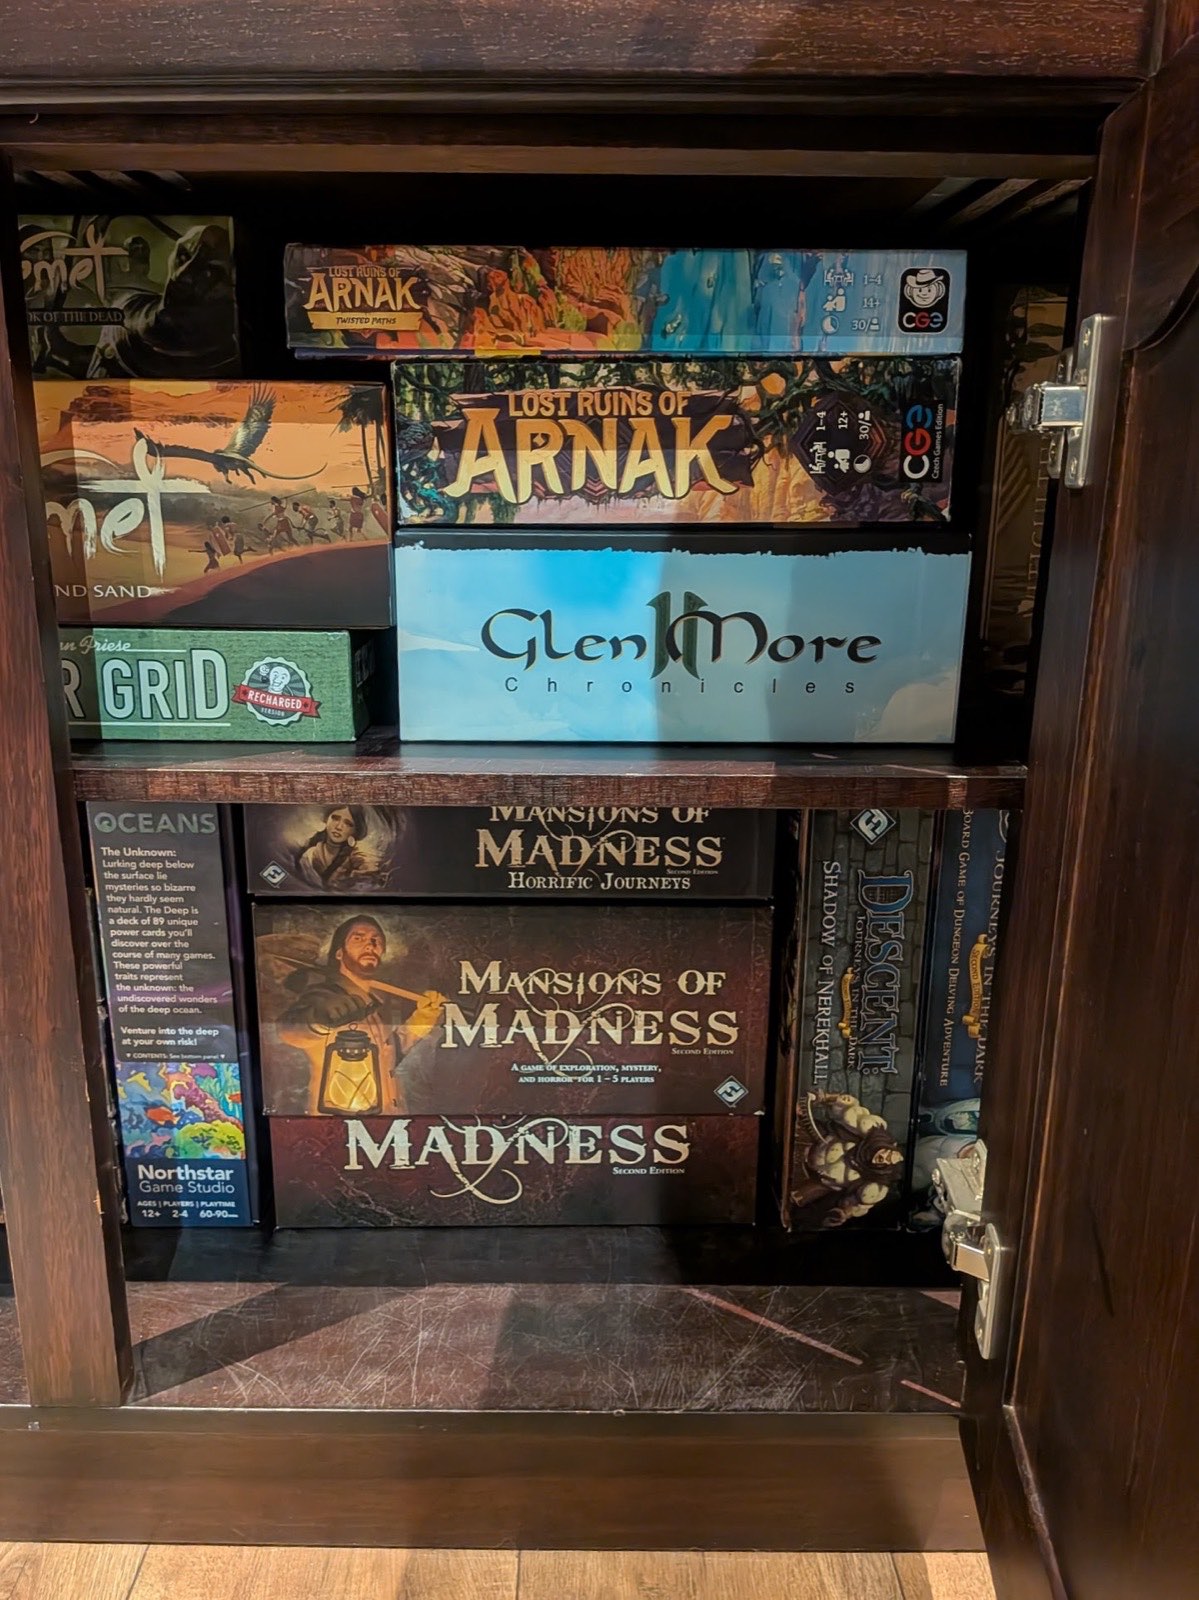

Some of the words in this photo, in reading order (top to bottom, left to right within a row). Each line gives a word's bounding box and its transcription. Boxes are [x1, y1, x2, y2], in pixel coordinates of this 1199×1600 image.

[329, 267, 355, 278] LOST
[356, 267, 386, 278] RUINS
[388, 267, 401, 278] OF
[303, 272, 422, 312] ARNAK
[863, 297, 881, 308] 14+
[89, 312, 123, 322] DEAD
[335, 316, 371, 325] TWISTED
[371, 317, 397, 325] PATHS
[508, 391, 571, 417] LOST
[578, 390, 655, 417] RUINS
[658, 391, 692, 417] OF
[838, 410, 849, 430] 12+
[934, 403, 944, 429] Edition
[933, 431, 943, 456] Games
[444, 408, 740, 505] ARNAK
[931, 457, 941, 479] Czech
[55, 584, 87, 598] ND
[93, 584, 151, 598] SAND
[79, 635, 131, 655] Friese
[481, 607, 648, 671] Glen
[665, 609, 883, 665] More
[102, 648, 230, 720] GRID
[505, 676, 856, 694] Chronicles
[247, 689, 303, 710] RECHARGED
[94, 812, 217, 834] OCEANS
[961, 806, 975, 849] BOARD
[101, 847, 120, 857] The
[123, 847, 177, 857] Unknown:
[475, 828, 724, 873] MADNESS
[102, 860, 137, 870] Lurking
[138, 860, 164, 871] deep
[165, 860, 196, 869] below
[957, 852, 971, 887] GAME
[104, 872, 120, 880] the
[121, 872, 155, 881] surface
[156, 872, 168, 880] lie
[508, 871, 594, 890] HORRIFIC
[600, 872, 692, 891] JOURNEYS
[105, 883, 149, 893] mysteries
[164, 883, 196, 892] bizarre
[106, 894, 127, 904] they
[128, 894, 158, 904] hardly
[821, 860, 842, 948] SHADOW
[955, 890, 965, 906] OF
[107, 906, 142, 914] natural.
[144, 906, 162, 914] The
[163, 906, 190, 916] Deep
[191, 906, 199, 914] is
[116, 916, 139, 925] deck
[140, 916, 151, 925] of
[152, 917, 165, 926] 89
[167, 917, 199, 927] unique
[110, 929, 140, 938] power
[141, 928, 167, 937] cards
[950, 909, 966, 965] DUNGEON
[111, 939, 149, 948] discover
[151, 940, 172, 948] over
[173, 939, 190, 948] the
[112, 951, 142, 959] course
[144, 950, 154, 959] of
[156, 952, 181, 961] many
[183, 952, 216, 961] games.
[112, 961, 141, 970] These
[142, 961, 183, 971] powerful
[819, 954, 834, 975] OF
[857, 869, 914, 1076] DESCENT:
[970, 949, 981, 980] SECOND
[114, 972, 139, 981] traits
[140, 974, 184, 982] represent
[457, 960, 662, 1004] MANSIONS
[677, 969, 727, 996] OF
[116, 983, 131, 992] the
[133, 983, 178, 992] unknown:
[179, 984, 194, 992] the
[945, 968, 960, 1015] DELVING
[117, 994, 177, 1003] undiscovered
[178, 995, 218, 1004] wonders
[118, 1005, 129, 1013] of
[130, 1005, 145, 1013] the
[147, 1005, 171, 1014] deep
[172, 1006, 203, 1014] ocean.
[120, 1026, 157, 1035] Venture
[158, 1027, 176, 1035] into
[177, 1027, 194, 1035] the
[195, 1027, 220, 1037] deep
[440, 1003, 740, 1060] MADNESS
[812, 979, 835, 1085] NEREKHALL
[133, 1039, 154, 1047] your
[177, 1037, 198, 1046] risk!
[671, 1047, 702, 1055] SECOND
[703, 1047, 734, 1055] EDITION
[847, 1035, 858, 1069] DARK
[939, 1018, 955, 1087] ADVENTURE
[511, 1063, 519, 1072] A
[546, 1064, 557, 1072] OF
[559, 1064, 620, 1073] EXPLORATION,
[621, 1065, 662, 1073] MYSTERY,
[597, 1075, 602, 1083] 1
[612, 1075, 618, 1083] 5
[344, 1117, 692, 1184] MADNESS
[137, 1164, 235, 1181] Northstar
[612, 1166, 647, 1175] SECOND
[649, 1166, 686, 1175] EDITION
[139, 1180, 184, 1194] Game
[187, 1181, 236, 1194] Studio
[141, 1209, 162, 1218] 12+
[172, 1209, 189, 1218] 2-4
